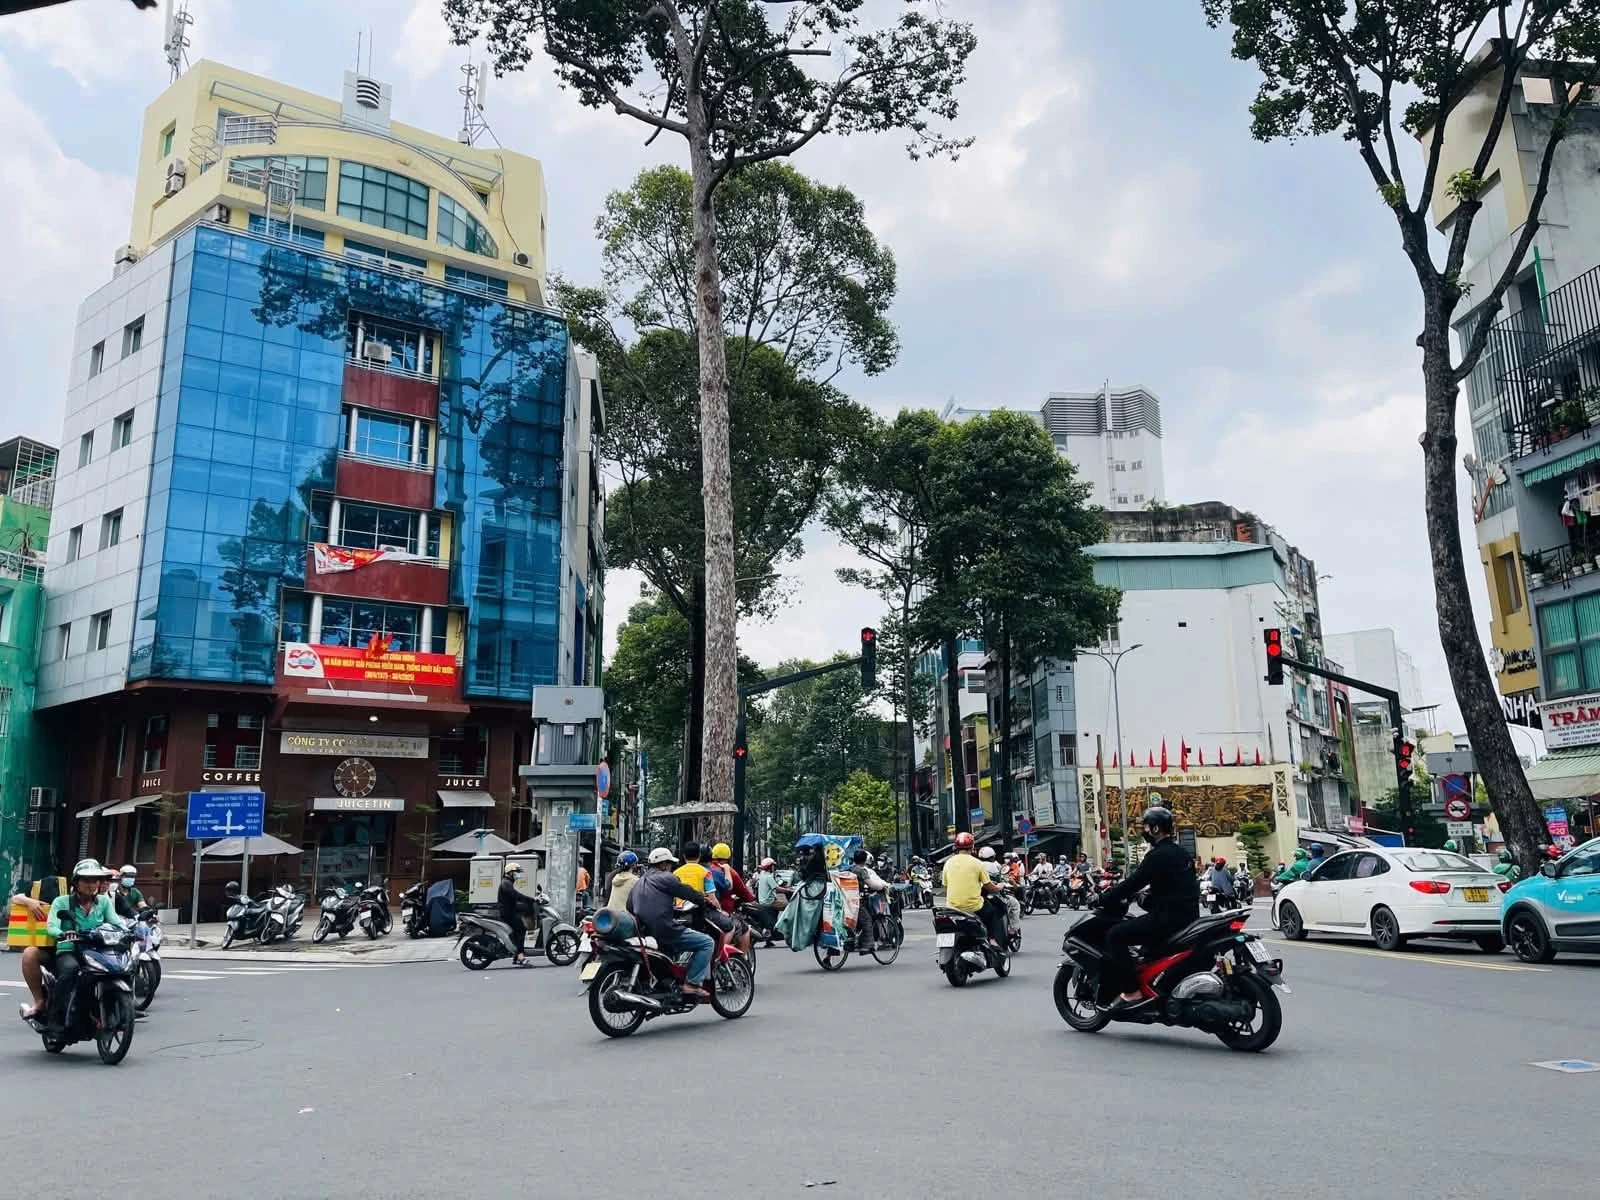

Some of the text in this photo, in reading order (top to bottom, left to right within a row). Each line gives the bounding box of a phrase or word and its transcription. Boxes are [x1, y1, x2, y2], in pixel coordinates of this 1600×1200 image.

[287, 735, 316, 747] CÔNG
[318, 738, 330, 747] TY
[202, 772, 261, 782] COFFEE
[142, 778, 161, 788] JUICE
[445, 778, 481, 787] JUICE
[336, 799, 393, 810] JUICETIN
